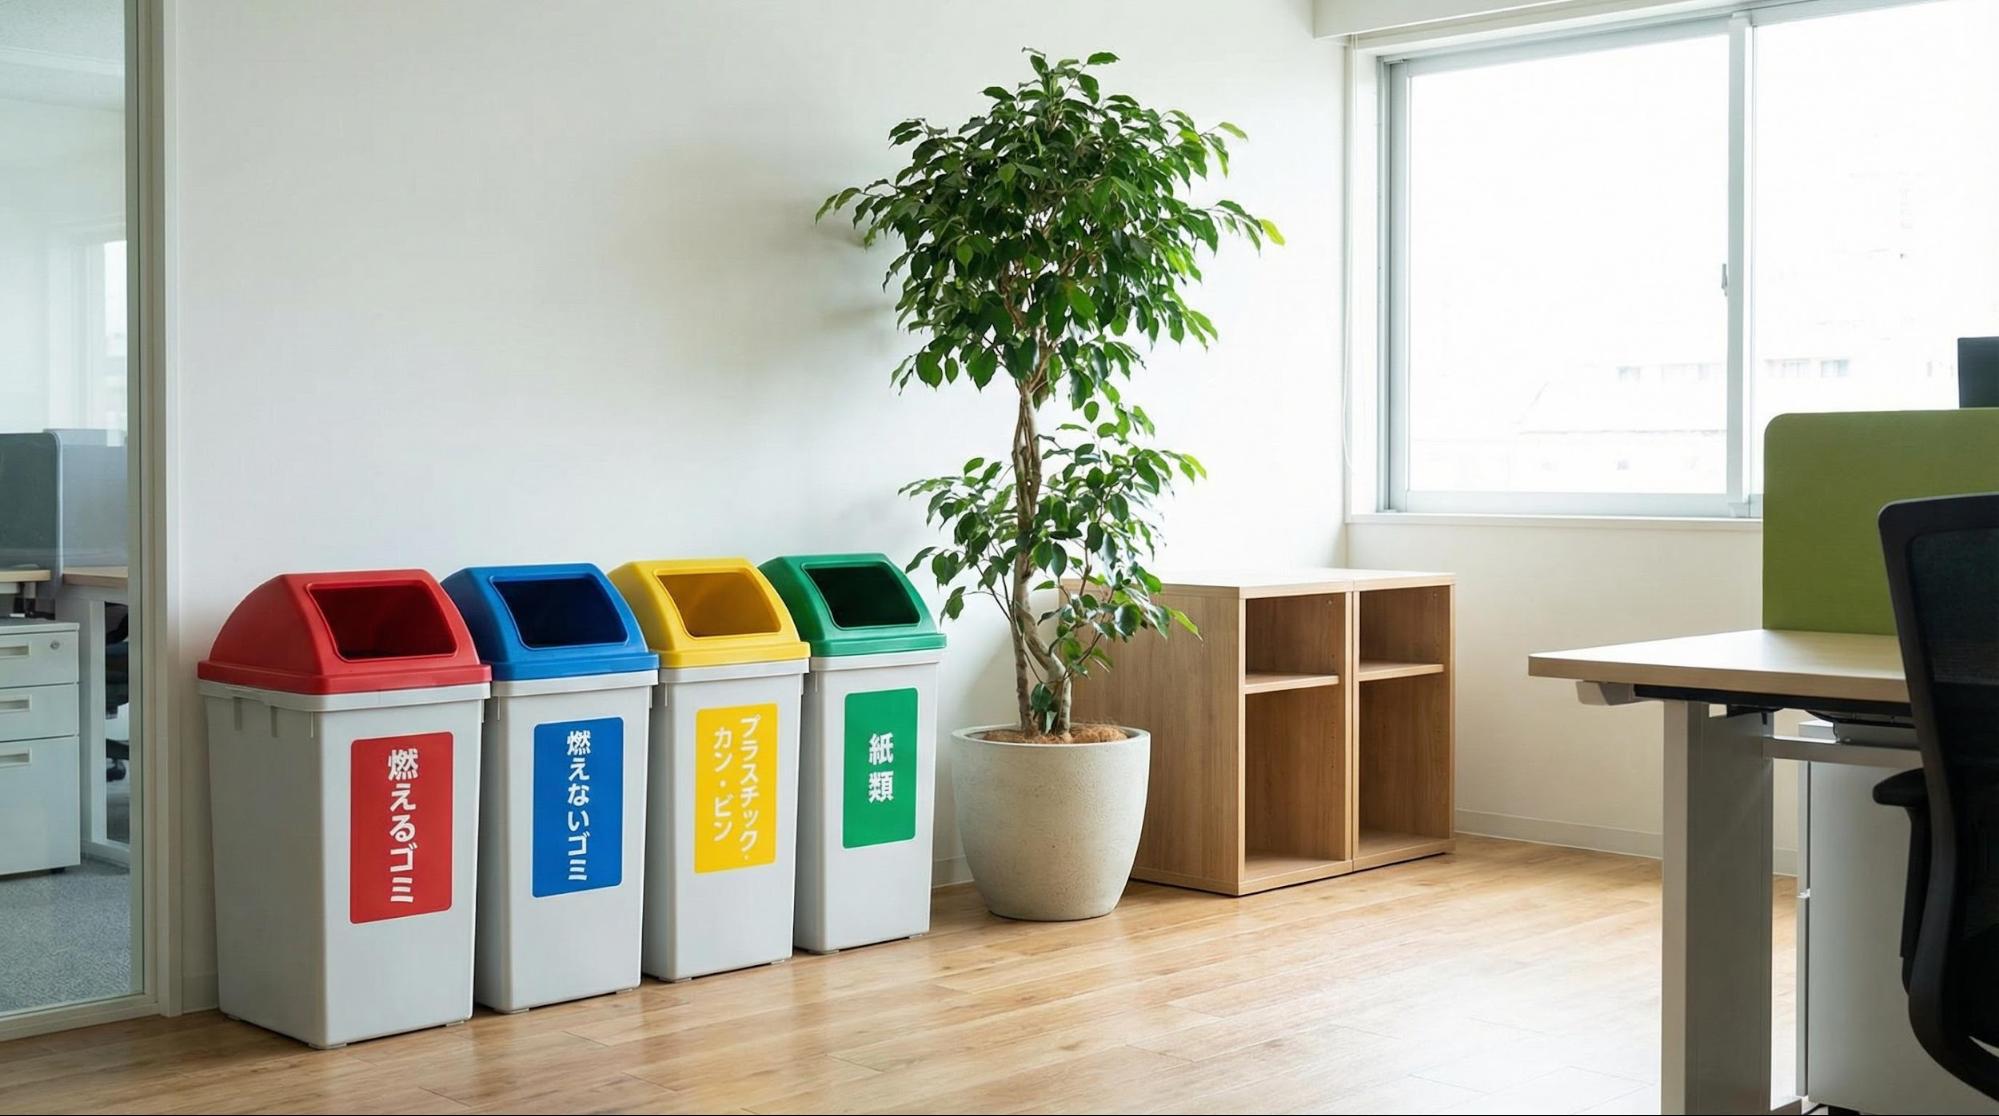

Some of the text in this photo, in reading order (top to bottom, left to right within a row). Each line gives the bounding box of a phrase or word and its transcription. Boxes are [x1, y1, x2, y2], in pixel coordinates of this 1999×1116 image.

[388, 748, 418, 903] 燃えるゴミ
[567, 730, 591, 881] 燃えないゴミ
[713, 727, 733, 842] カン・ビン
[868, 732, 894, 803] 紙類
